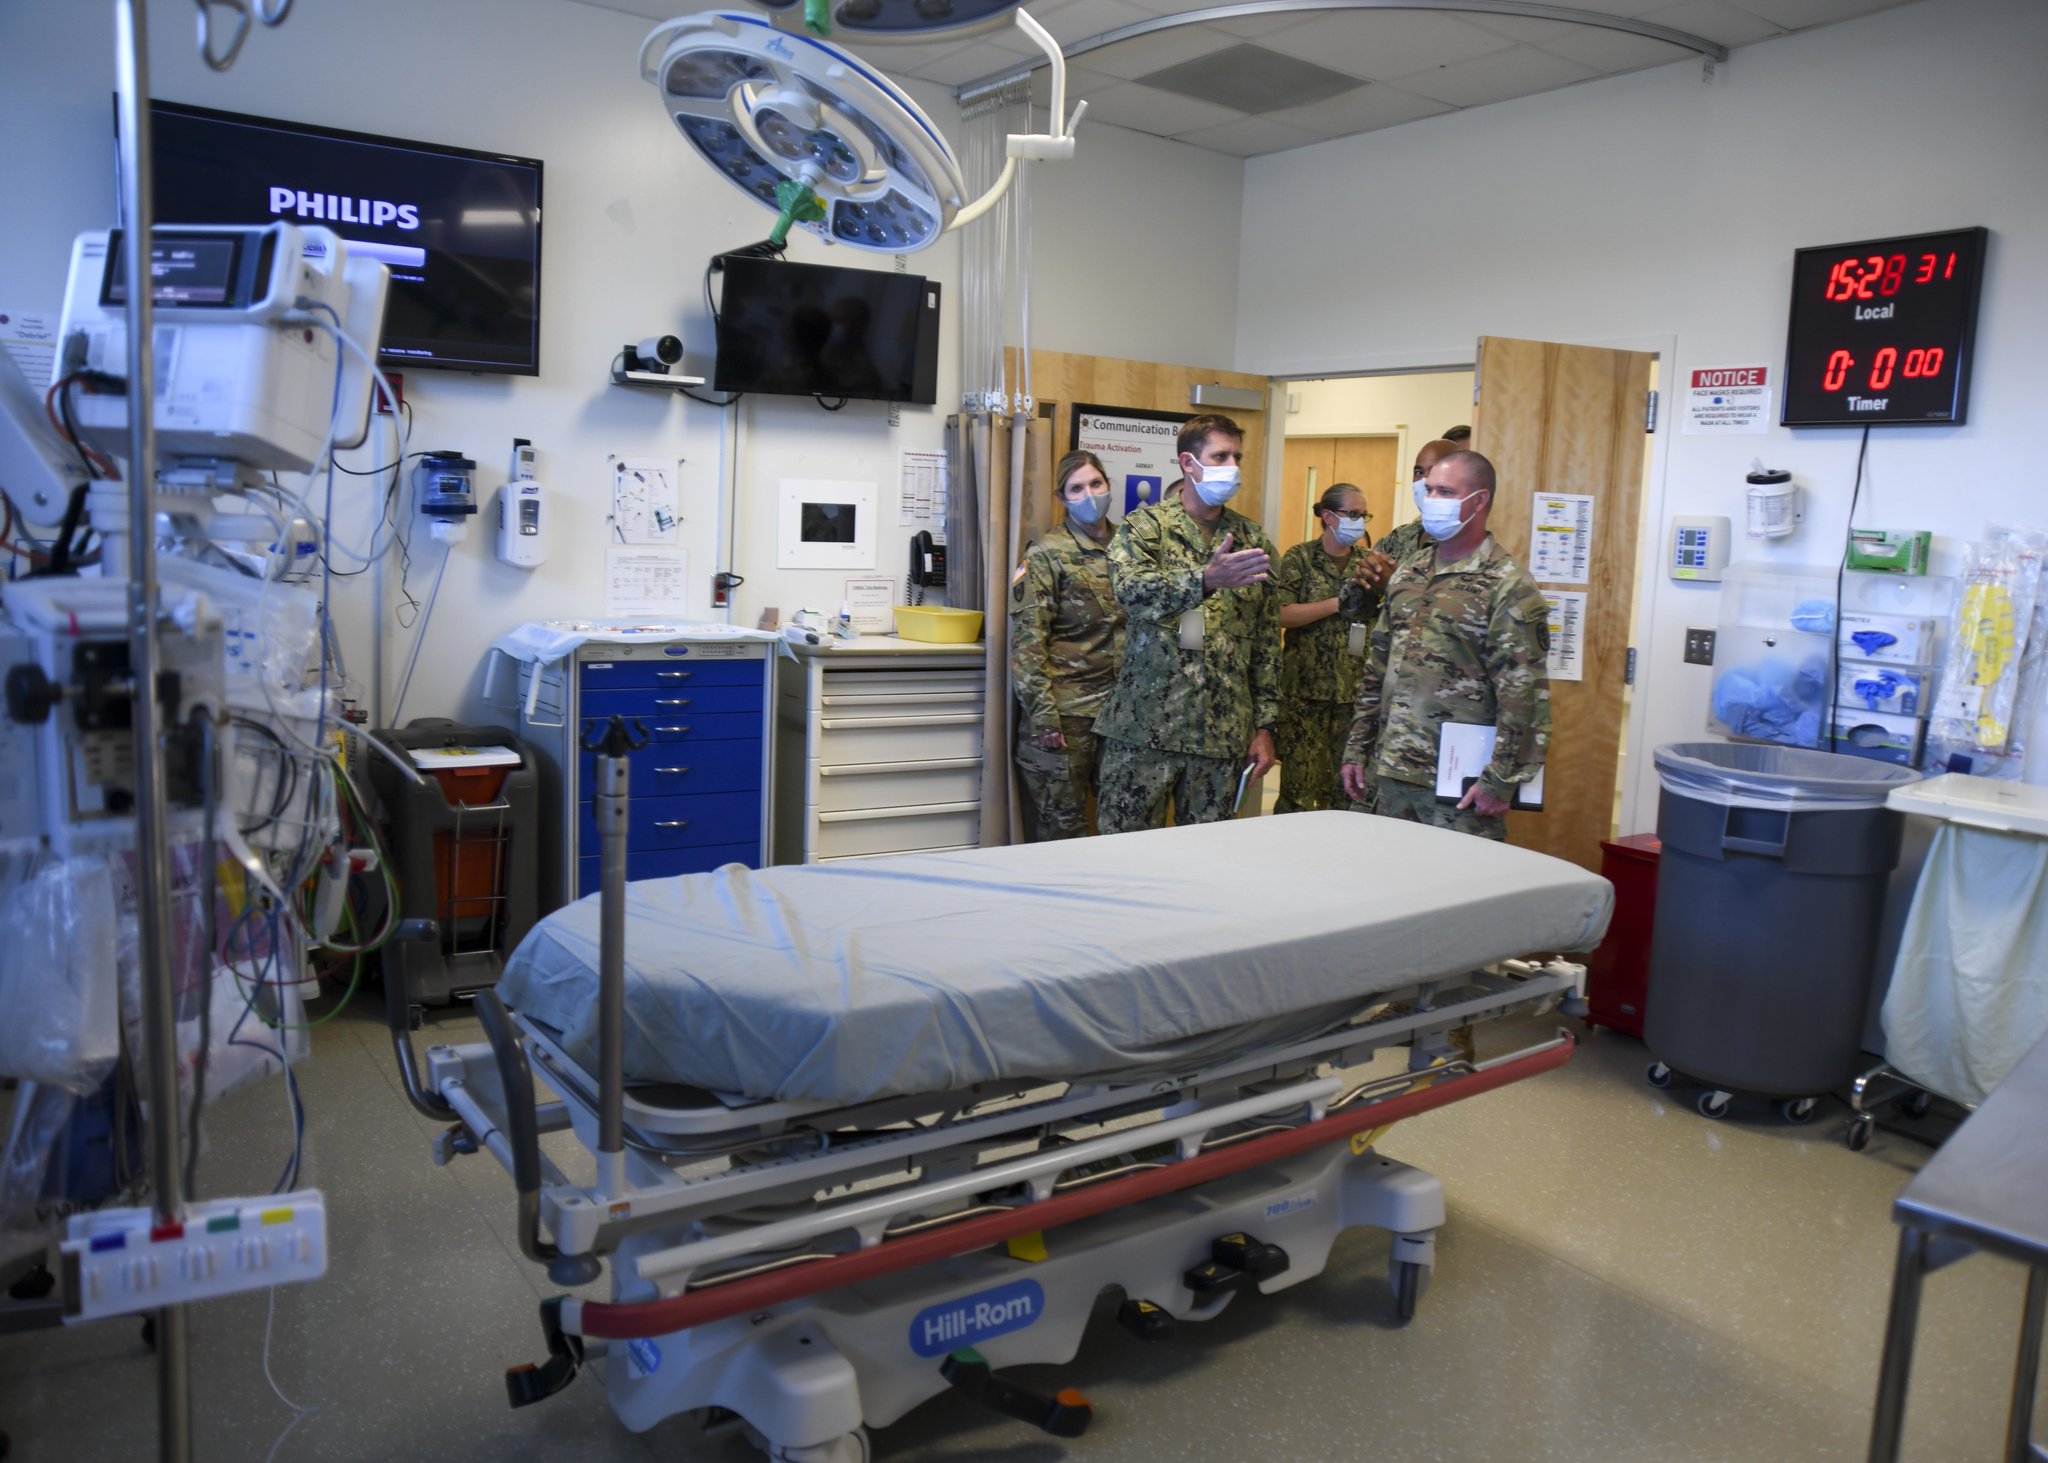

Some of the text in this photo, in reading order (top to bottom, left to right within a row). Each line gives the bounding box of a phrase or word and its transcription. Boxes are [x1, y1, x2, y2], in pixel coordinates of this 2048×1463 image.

[270, 187, 419, 230] PHILIPS
[1855, 303, 1894, 320] Local
[1699, 370, 1759, 386] NOTICE
[1848, 396, 1888, 411] Timer
[1093, 418, 1171, 436] Communication
[1080, 441, 1142, 453] Trauma Activation
[924, 1296, 1031, 1346] Hill-Rom
